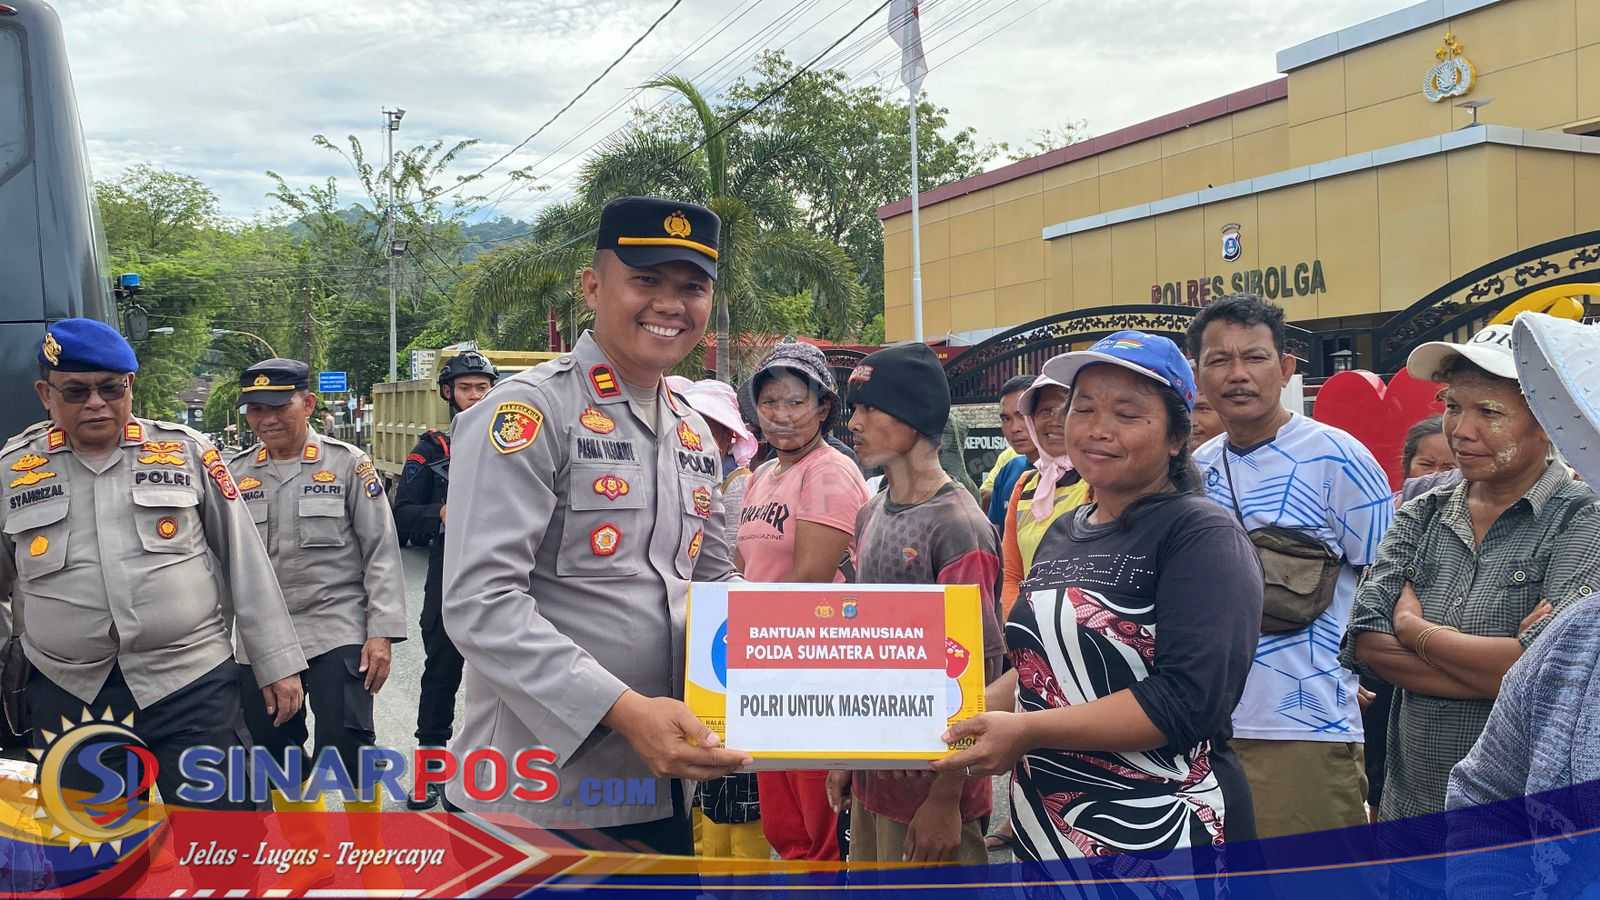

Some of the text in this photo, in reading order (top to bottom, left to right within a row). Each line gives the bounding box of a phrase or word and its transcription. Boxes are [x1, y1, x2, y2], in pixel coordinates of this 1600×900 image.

[1152, 259, 1327, 307] POLRES SIBOLGA
[678, 451, 716, 476] POLRI
[135, 471, 191, 487] POLRI
[9, 484, 65, 510] SYAHRIZAL
[303, 484, 341, 495] POLRI
[749, 626, 924, 640] BANTUAN KEMANUSIAAN
[745, 644, 928, 660] POLDA SUMATERA UTARA
[739, 694, 935, 718] POLRI UNTUK MASYARAKAT
